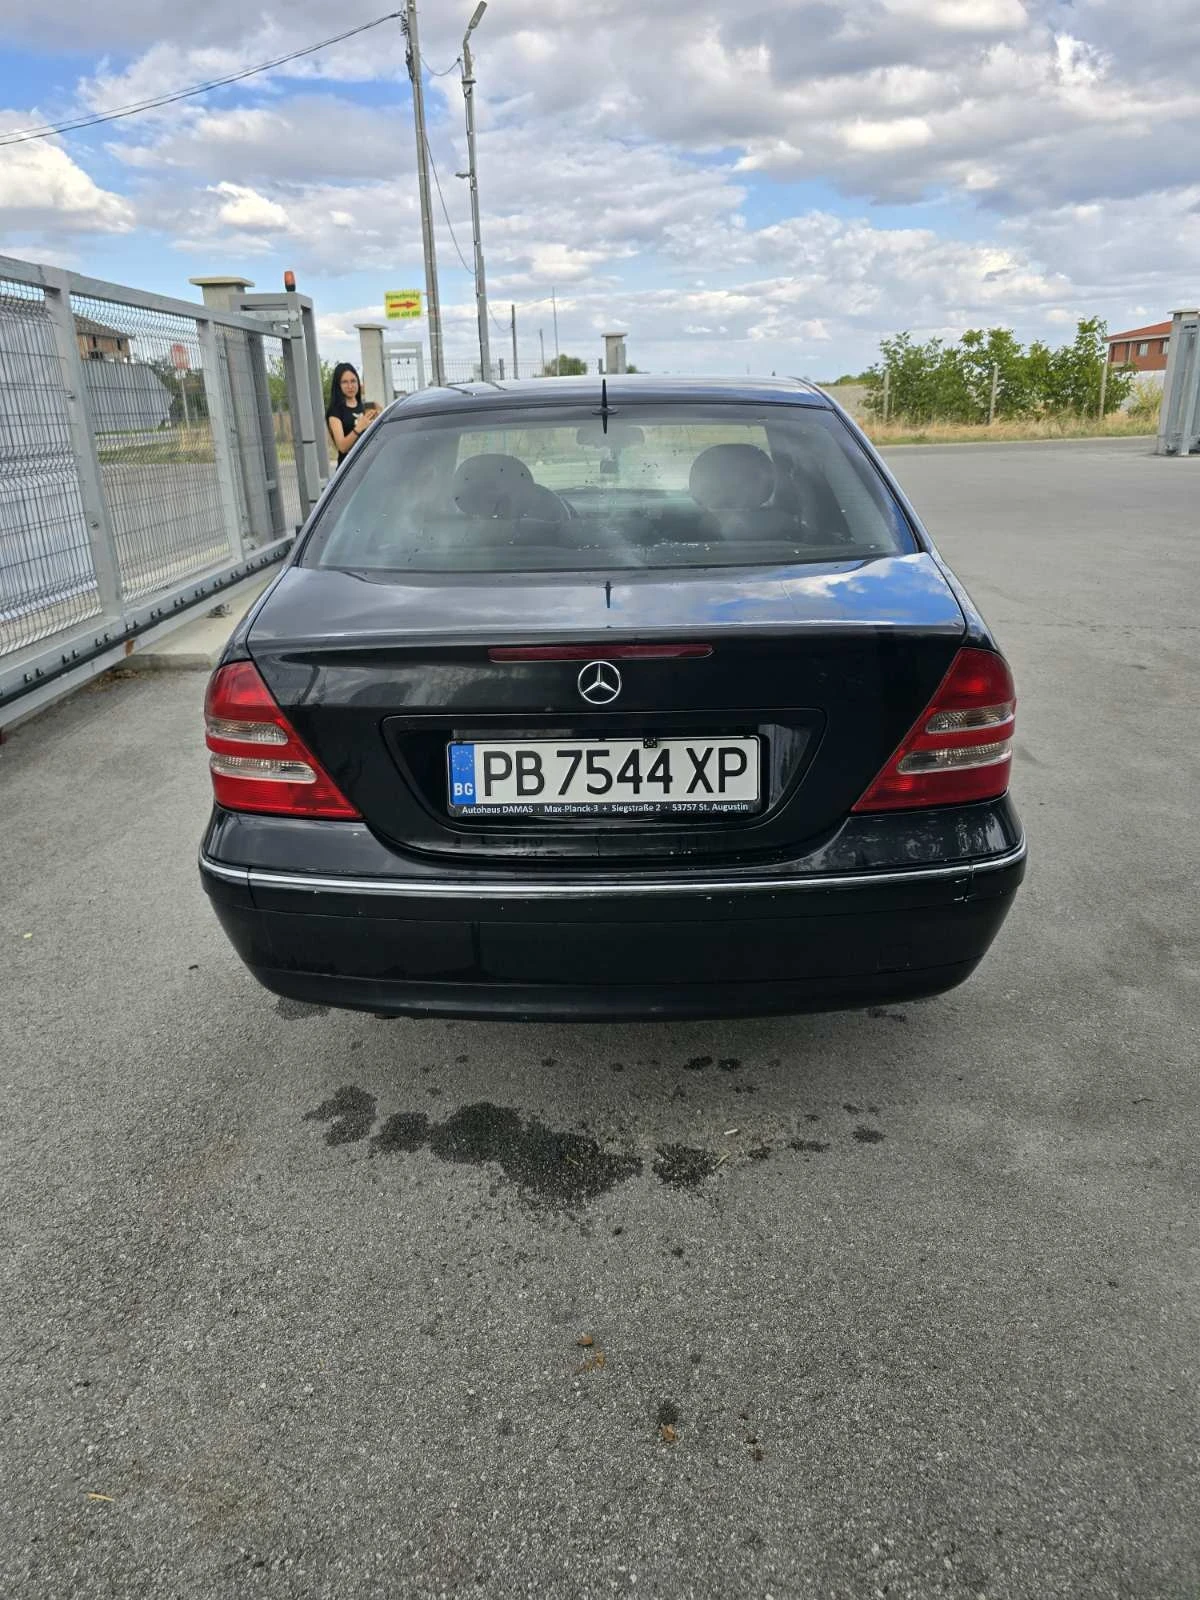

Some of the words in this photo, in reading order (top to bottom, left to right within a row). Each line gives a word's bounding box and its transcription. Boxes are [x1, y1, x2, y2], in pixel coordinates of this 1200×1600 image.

[483, 750, 546, 797] PB
[556, 749, 673, 795] 7544
[685, 747, 748, 794] XP
[453, 782, 474, 796] BG
[462, 806, 501, 814] Autohaus
[502, 805, 534, 813] DAMAS
[544, 804, 599, 813] Max-Planck-3
[611, 804, 654, 813] Siegstraße
[672, 803, 697, 811] 53757
[699, 803, 710, 811] St.
[711, 802, 749, 812] Augustin
